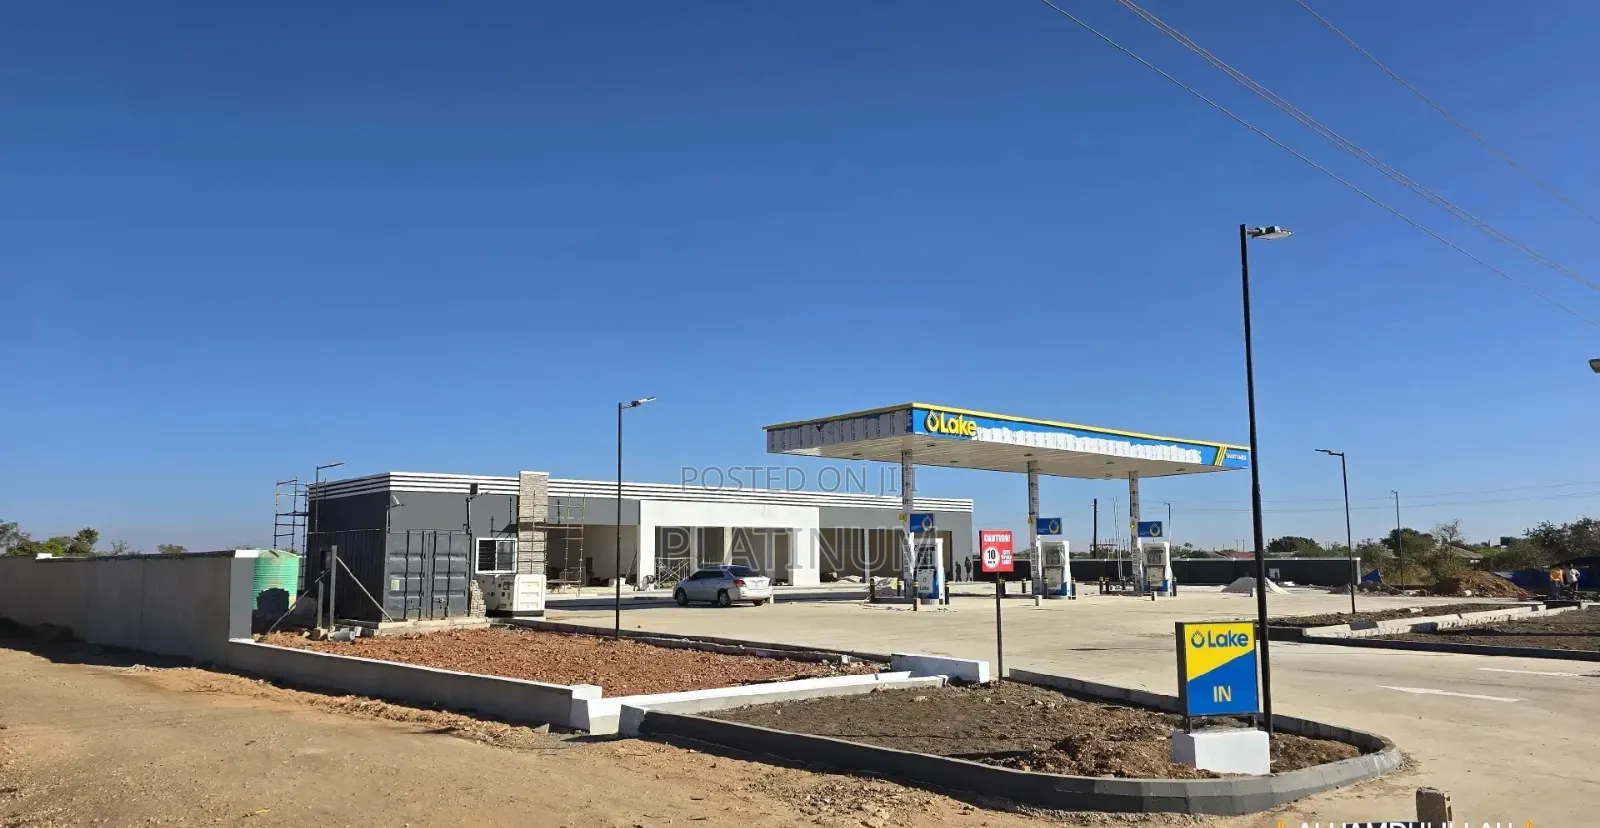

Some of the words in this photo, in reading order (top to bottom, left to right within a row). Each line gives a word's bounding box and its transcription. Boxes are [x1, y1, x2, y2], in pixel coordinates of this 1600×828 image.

[940, 411, 977, 437] Lake
[987, 549, 996, 560] 10
[1207, 629, 1249, 648] Lake
[1213, 685, 1232, 703] IN
